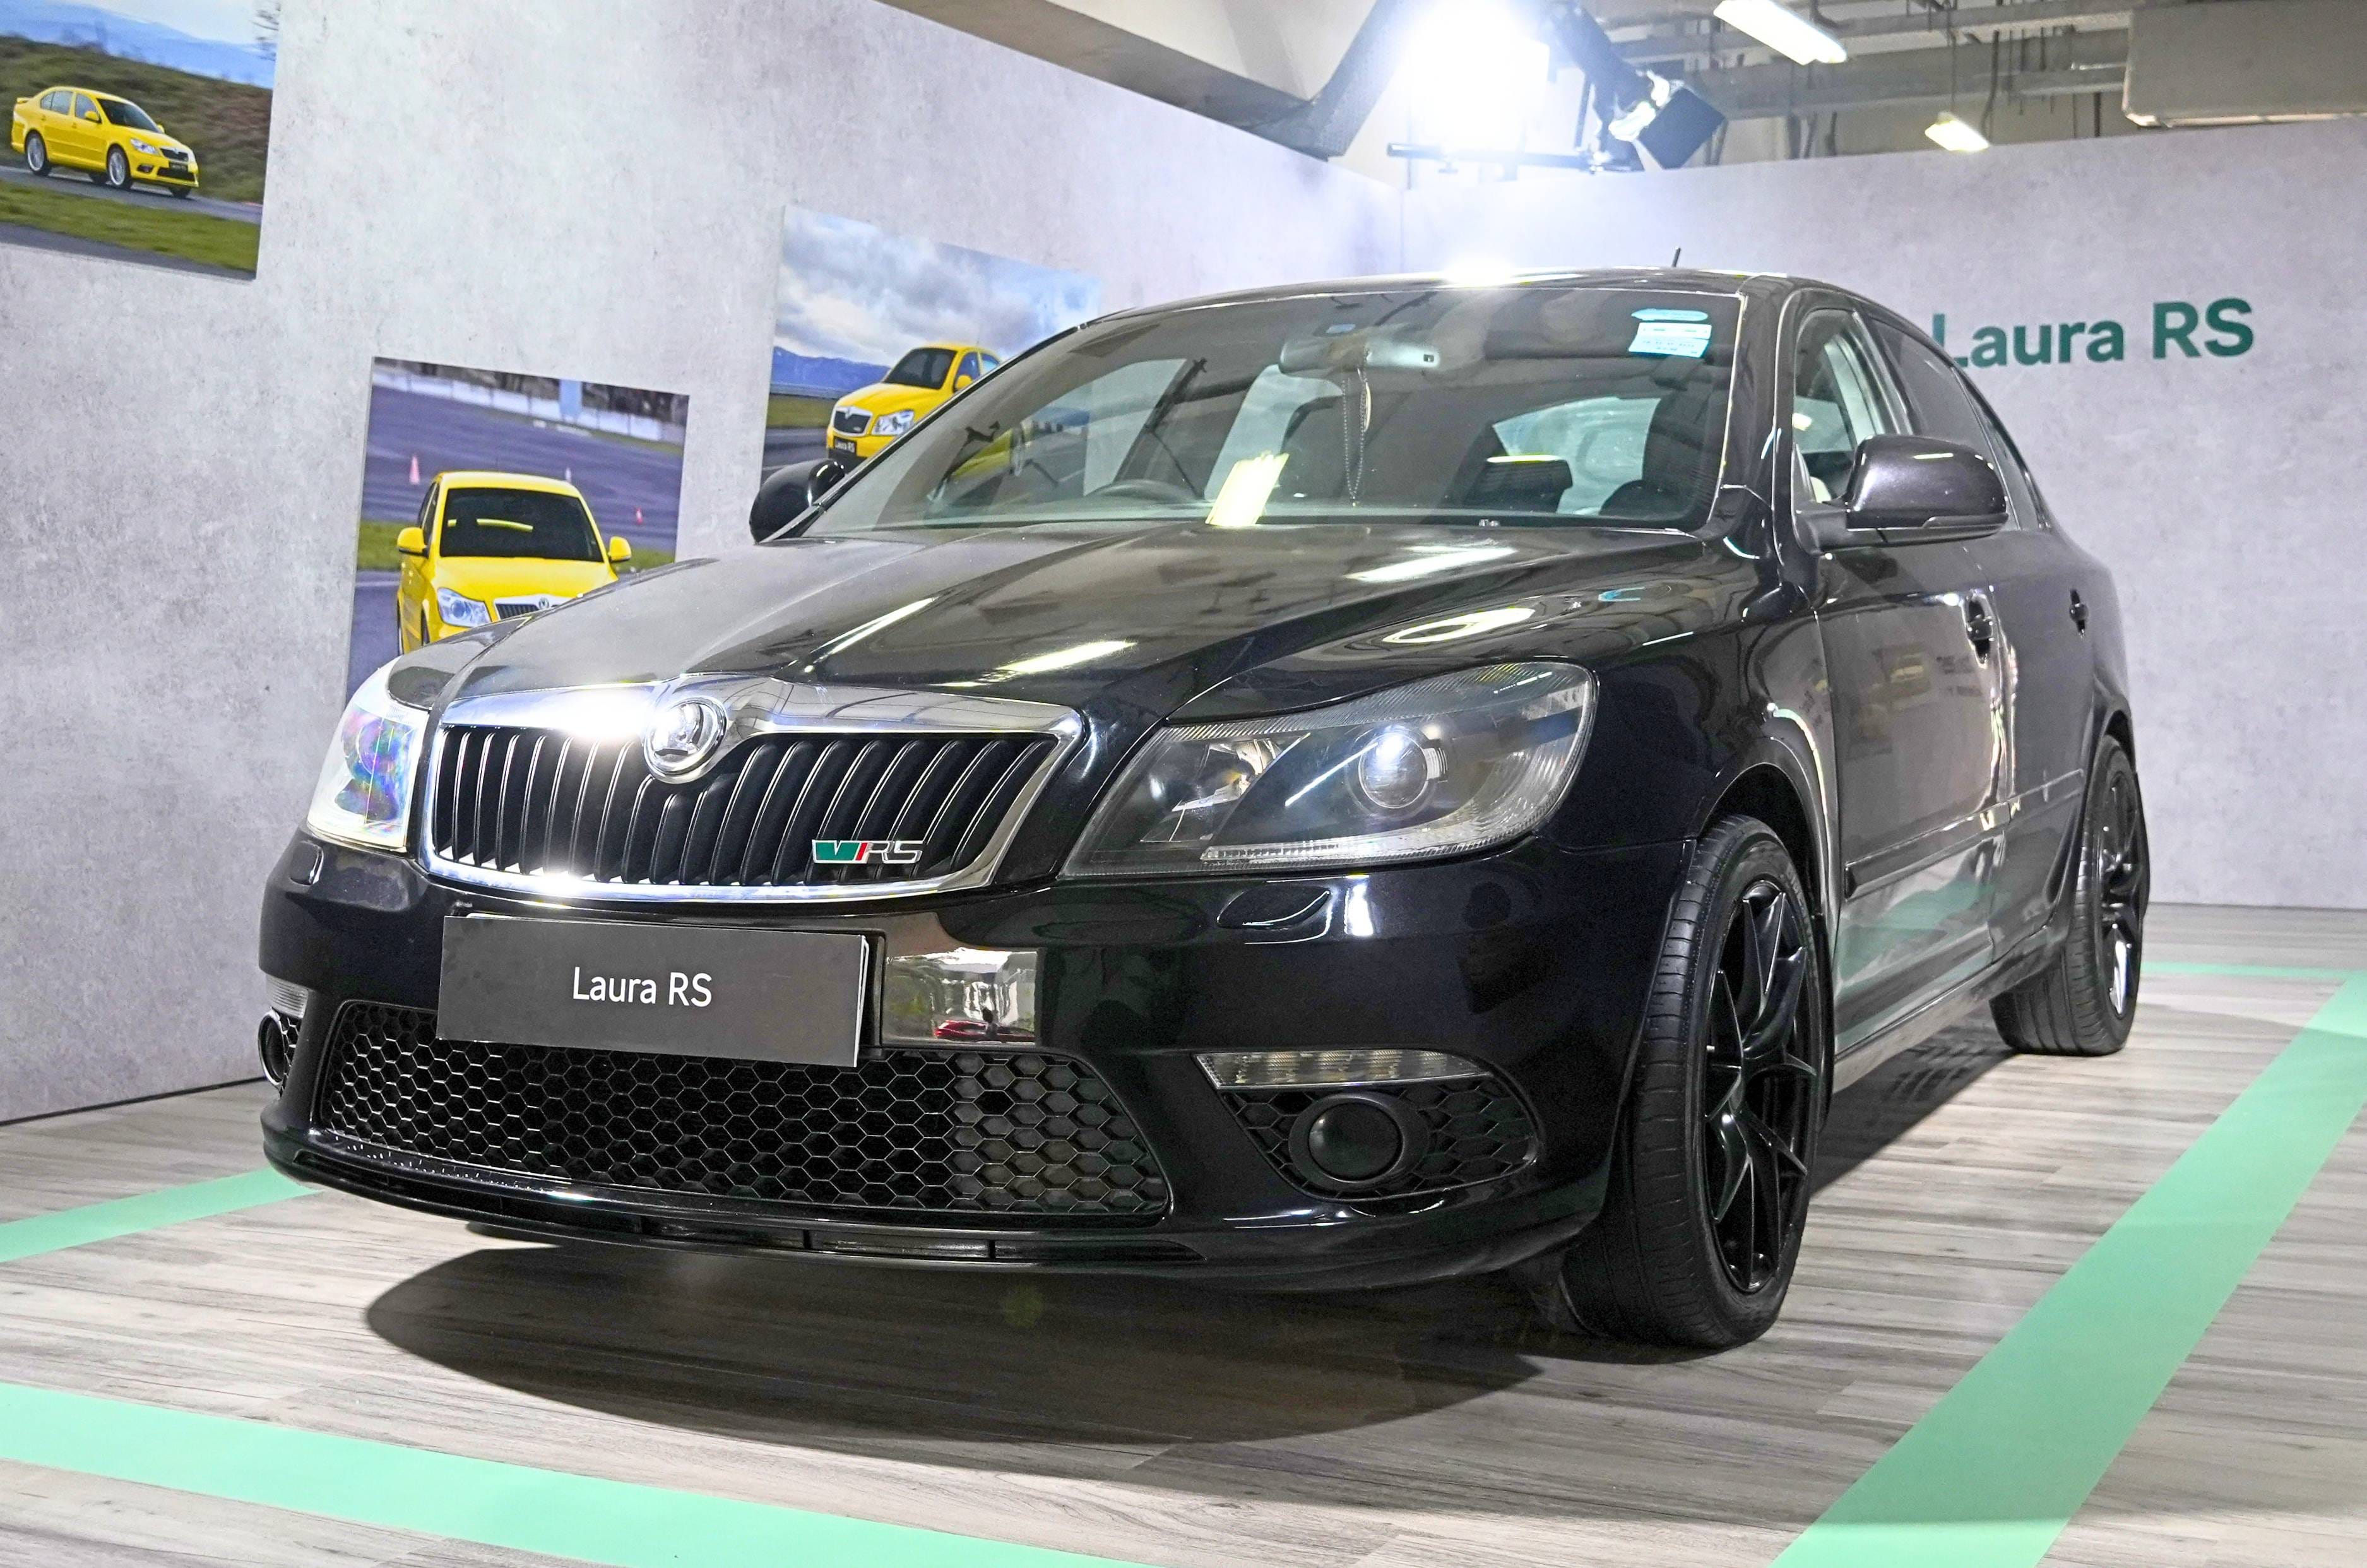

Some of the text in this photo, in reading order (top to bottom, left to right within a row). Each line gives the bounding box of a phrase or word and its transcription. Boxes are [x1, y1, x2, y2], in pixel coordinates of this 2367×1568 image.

[1932, 297, 2254, 367] Laura RS
[572, 966, 713, 1007] Laura RS
